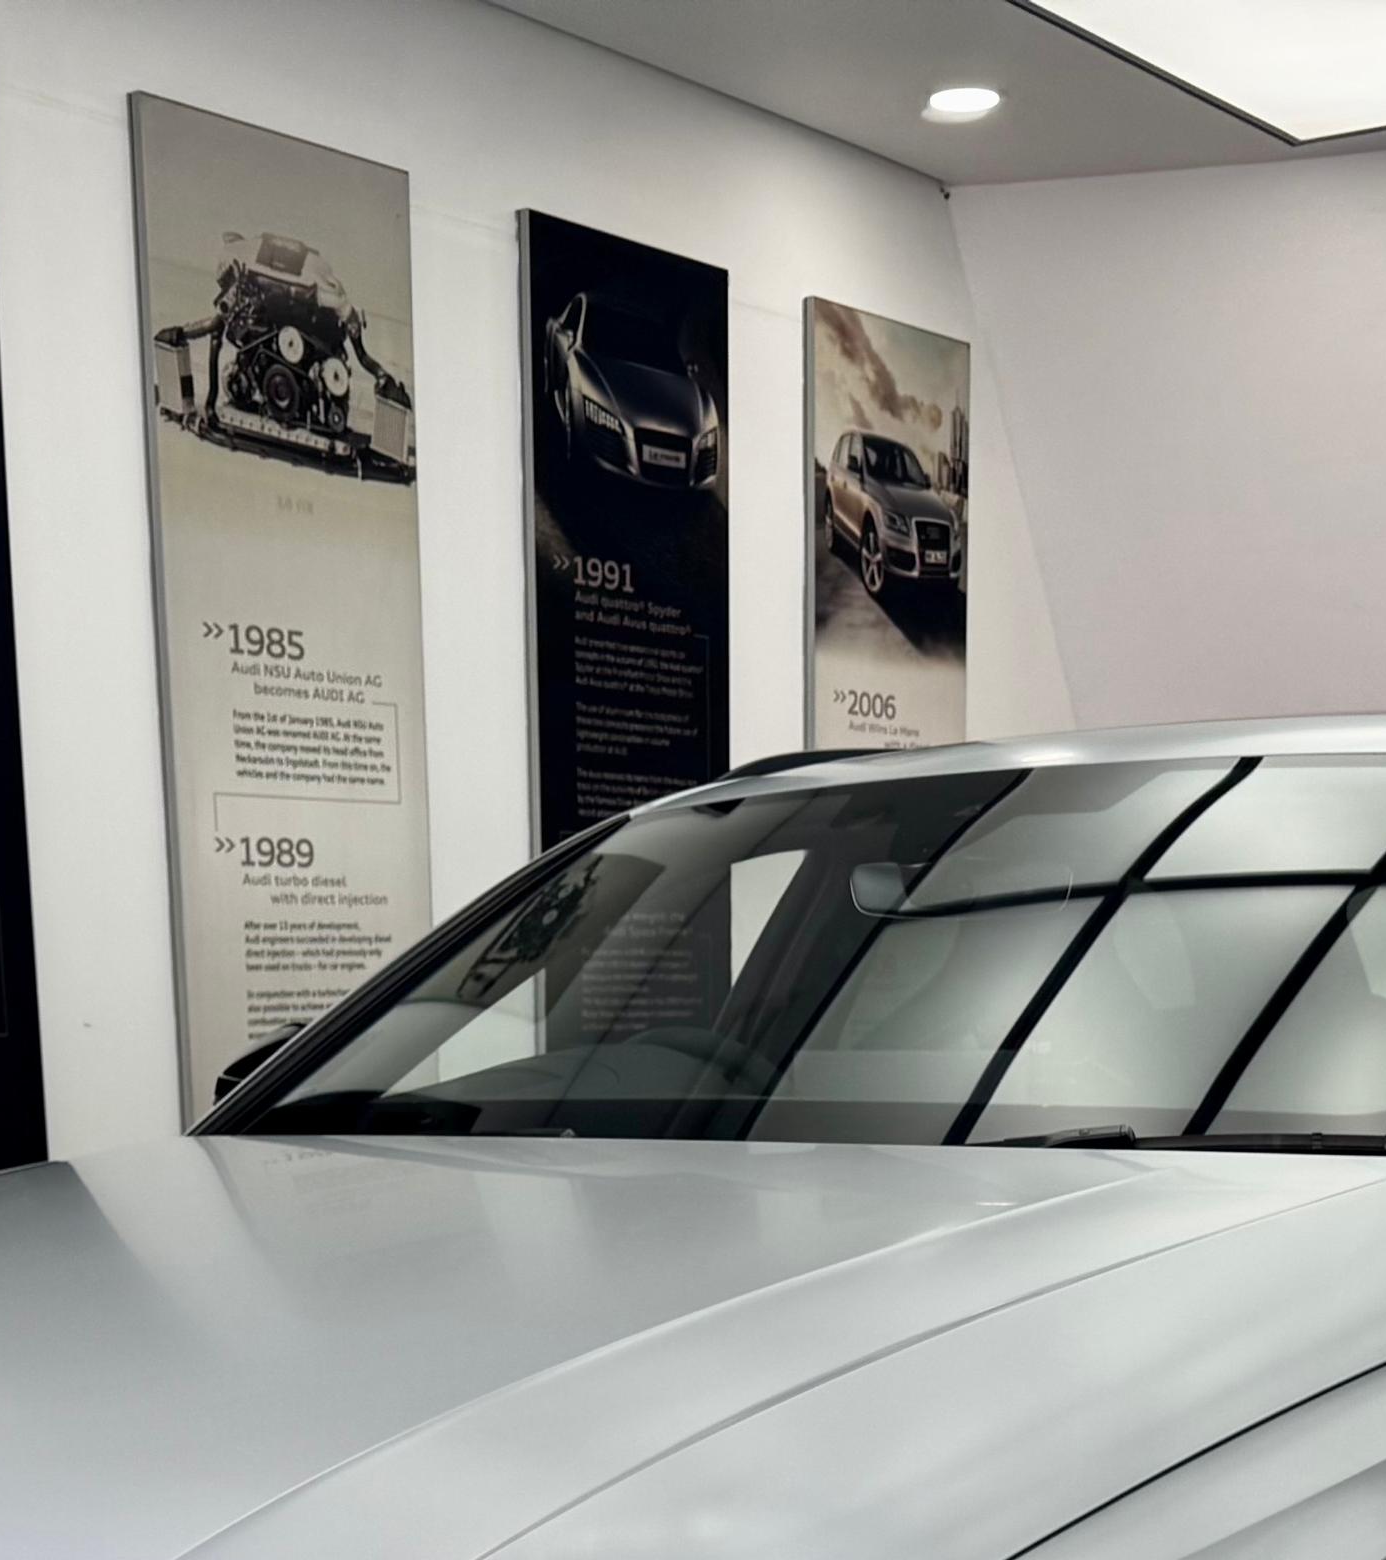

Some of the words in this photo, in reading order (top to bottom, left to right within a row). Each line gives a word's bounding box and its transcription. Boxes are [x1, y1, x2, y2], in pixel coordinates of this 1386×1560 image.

[574, 557, 632, 591] 1991
[229, 624, 304, 660] 1985
[232, 661, 260, 675] Audi
[264, 664, 290, 678] NSU
[294, 668, 323, 682] Auto
[327, 671, 361, 685] Union
[365, 675, 381, 687] AG
[254, 682, 309, 699] becomes
[313, 687, 343, 702] AUDI
[347, 691, 364, 703] AG
[848, 690, 895, 719] 2006
[240, 837, 314, 868] 1989
[242, 873, 271, 886] Audi
[274, 875, 309, 886] turbo
[312, 876, 346, 887] diesel
[270, 892, 298, 904] with
[301, 893, 335, 905] direct
[338, 894, 387, 908] injection
